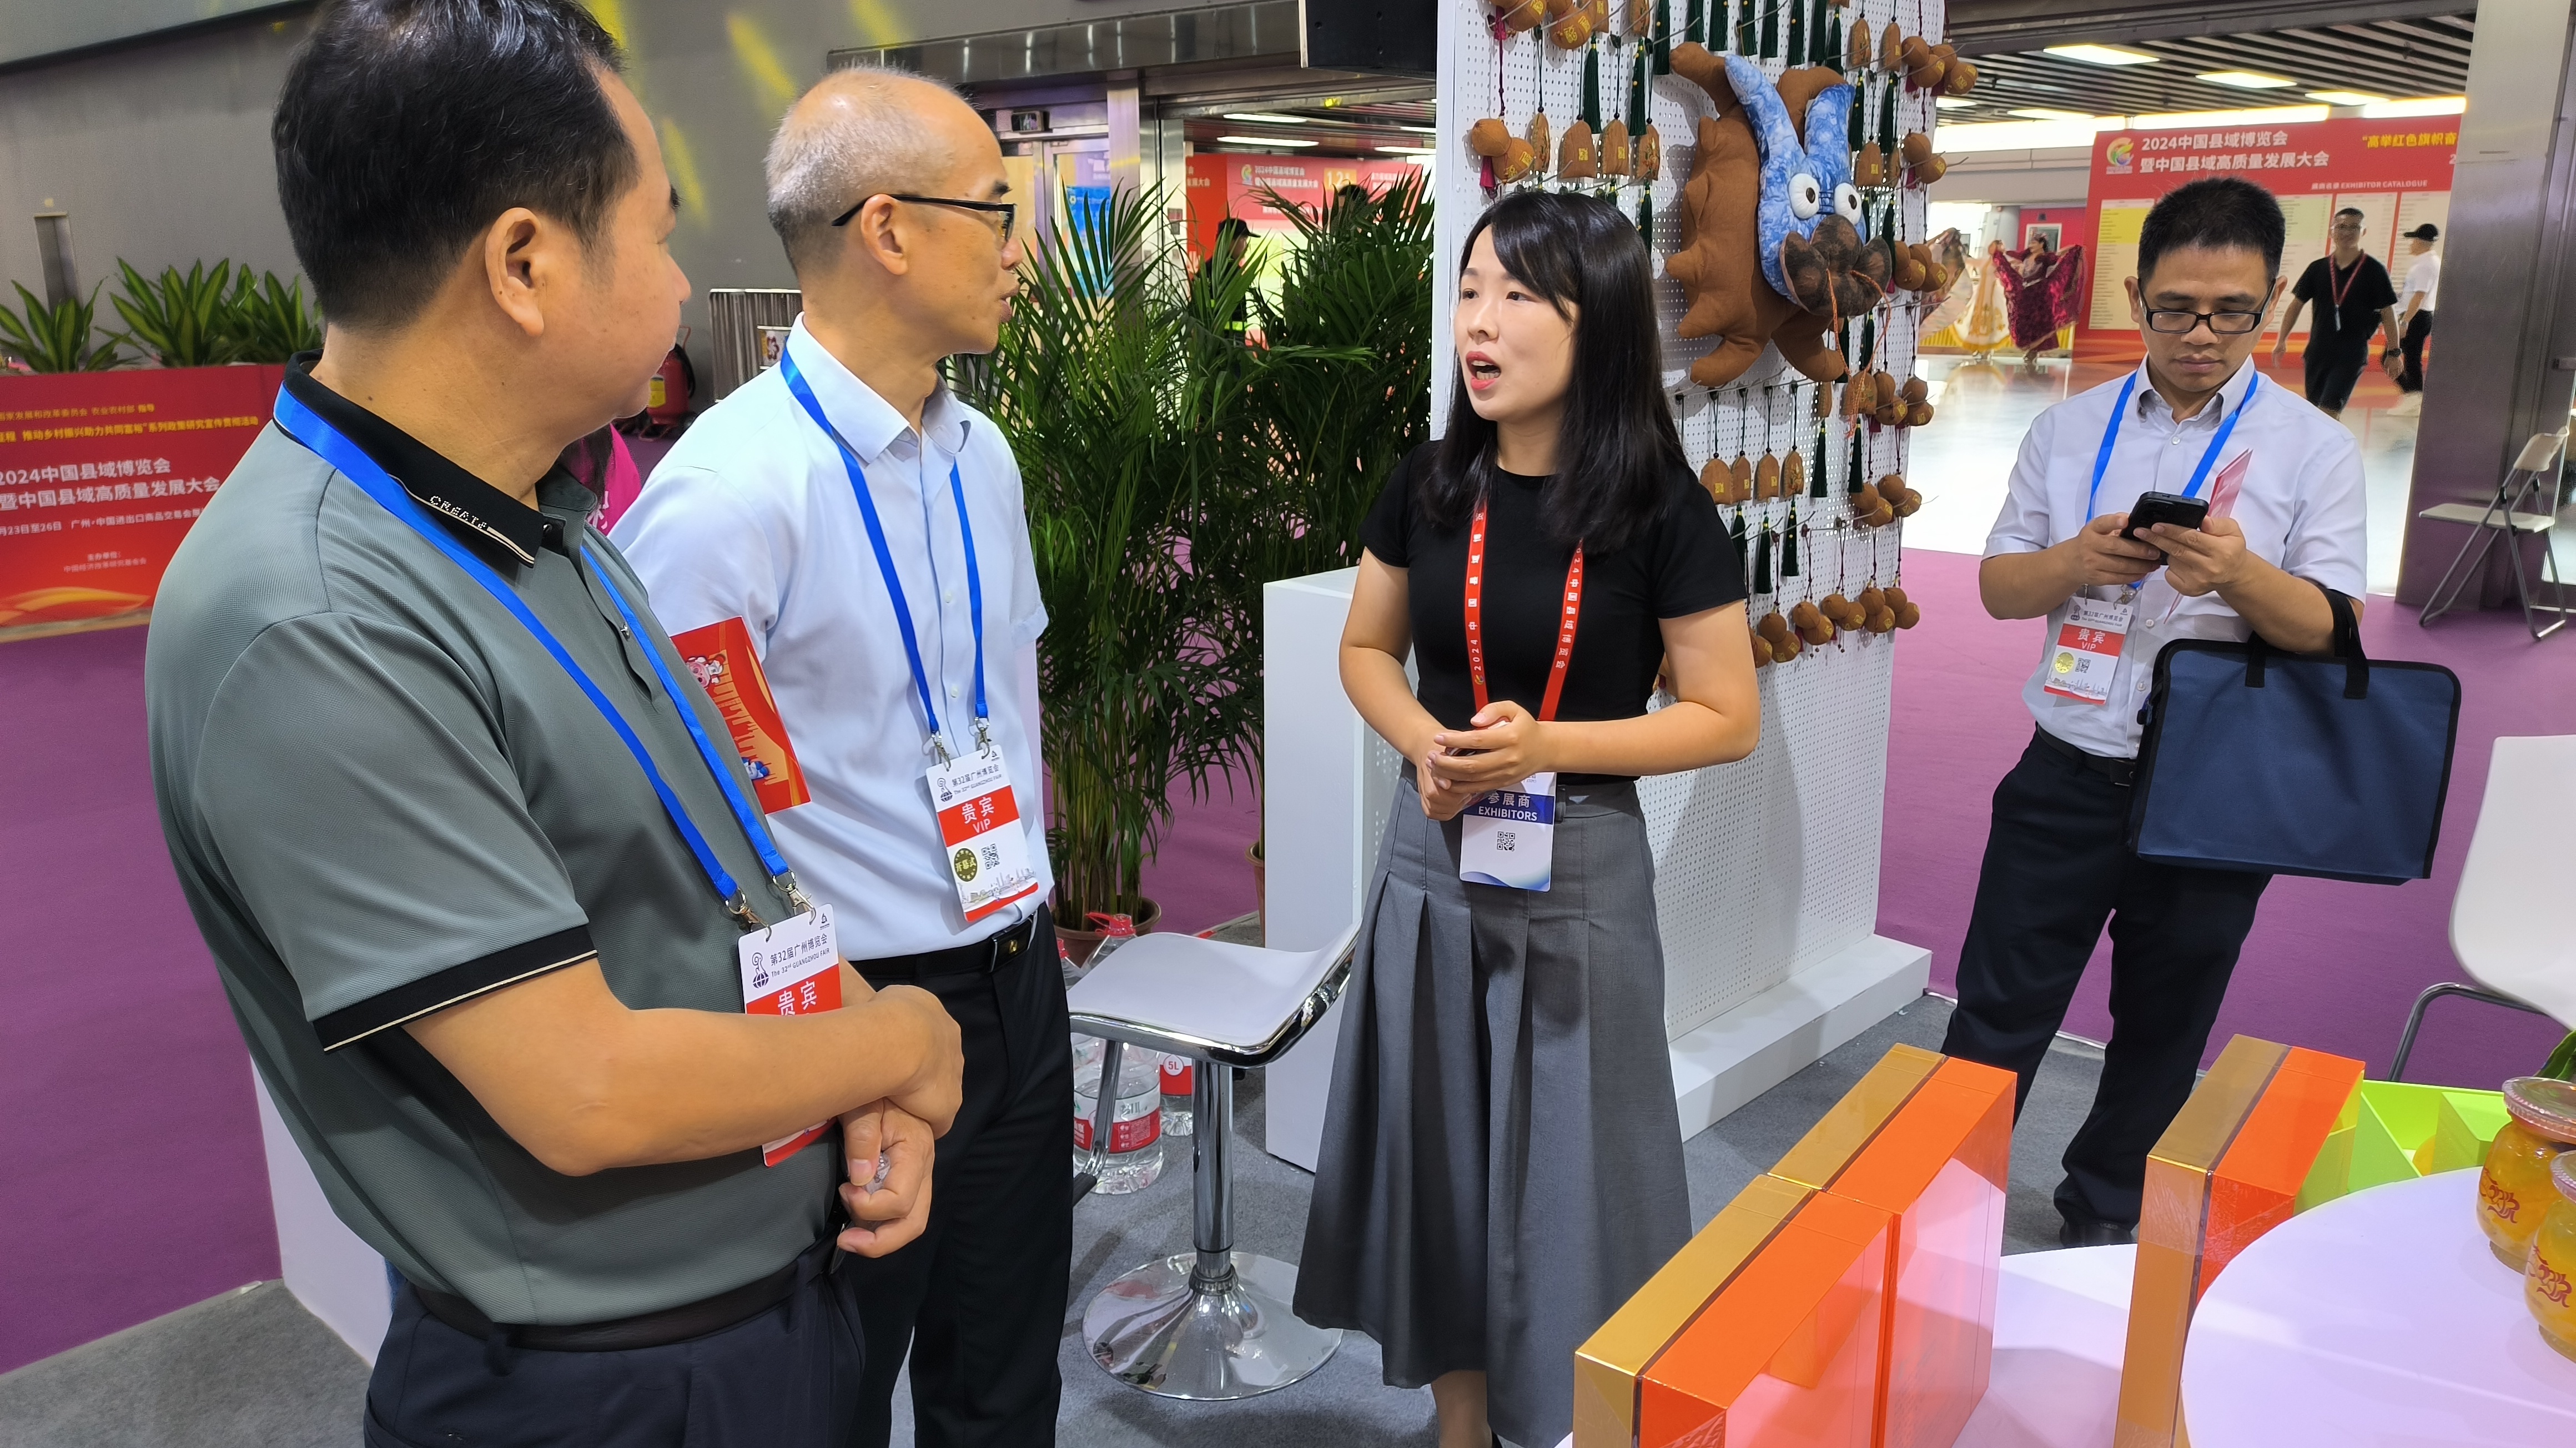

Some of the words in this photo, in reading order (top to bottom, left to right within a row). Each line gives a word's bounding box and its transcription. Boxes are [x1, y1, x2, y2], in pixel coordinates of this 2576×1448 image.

[2141, 130, 2288, 150] 2024中国县域博览会
[2139, 150, 2330, 173] 暨中国县域高质量发展大会
[2341, 181, 2381, 189] EXHIBITOR
[2383, 179, 2428, 188] CATALOGUE
[0, 457, 171, 486] 2024中国县域博览会
[0, 476, 220, 511] 暨中国县域高质量发展大会
[2082, 641, 2096, 650] VIP
[952, 764, 999, 787] 第32届广州博览会
[962, 797, 994, 824] 贵宾
[1488, 792, 1531, 808] 参展商
[1478, 806, 1538, 821] EXHIBITORS
[972, 818, 991, 833] VIP
[770, 933, 827, 967] 第32届广州博览会
[771, 968, 780, 978] The
[782, 963, 792, 974] 32nd
[792, 953, 819, 969] GUANGZHOU
[820, 948, 830, 958] FAIR
[1168, 1061, 1179, 1070] 5L
